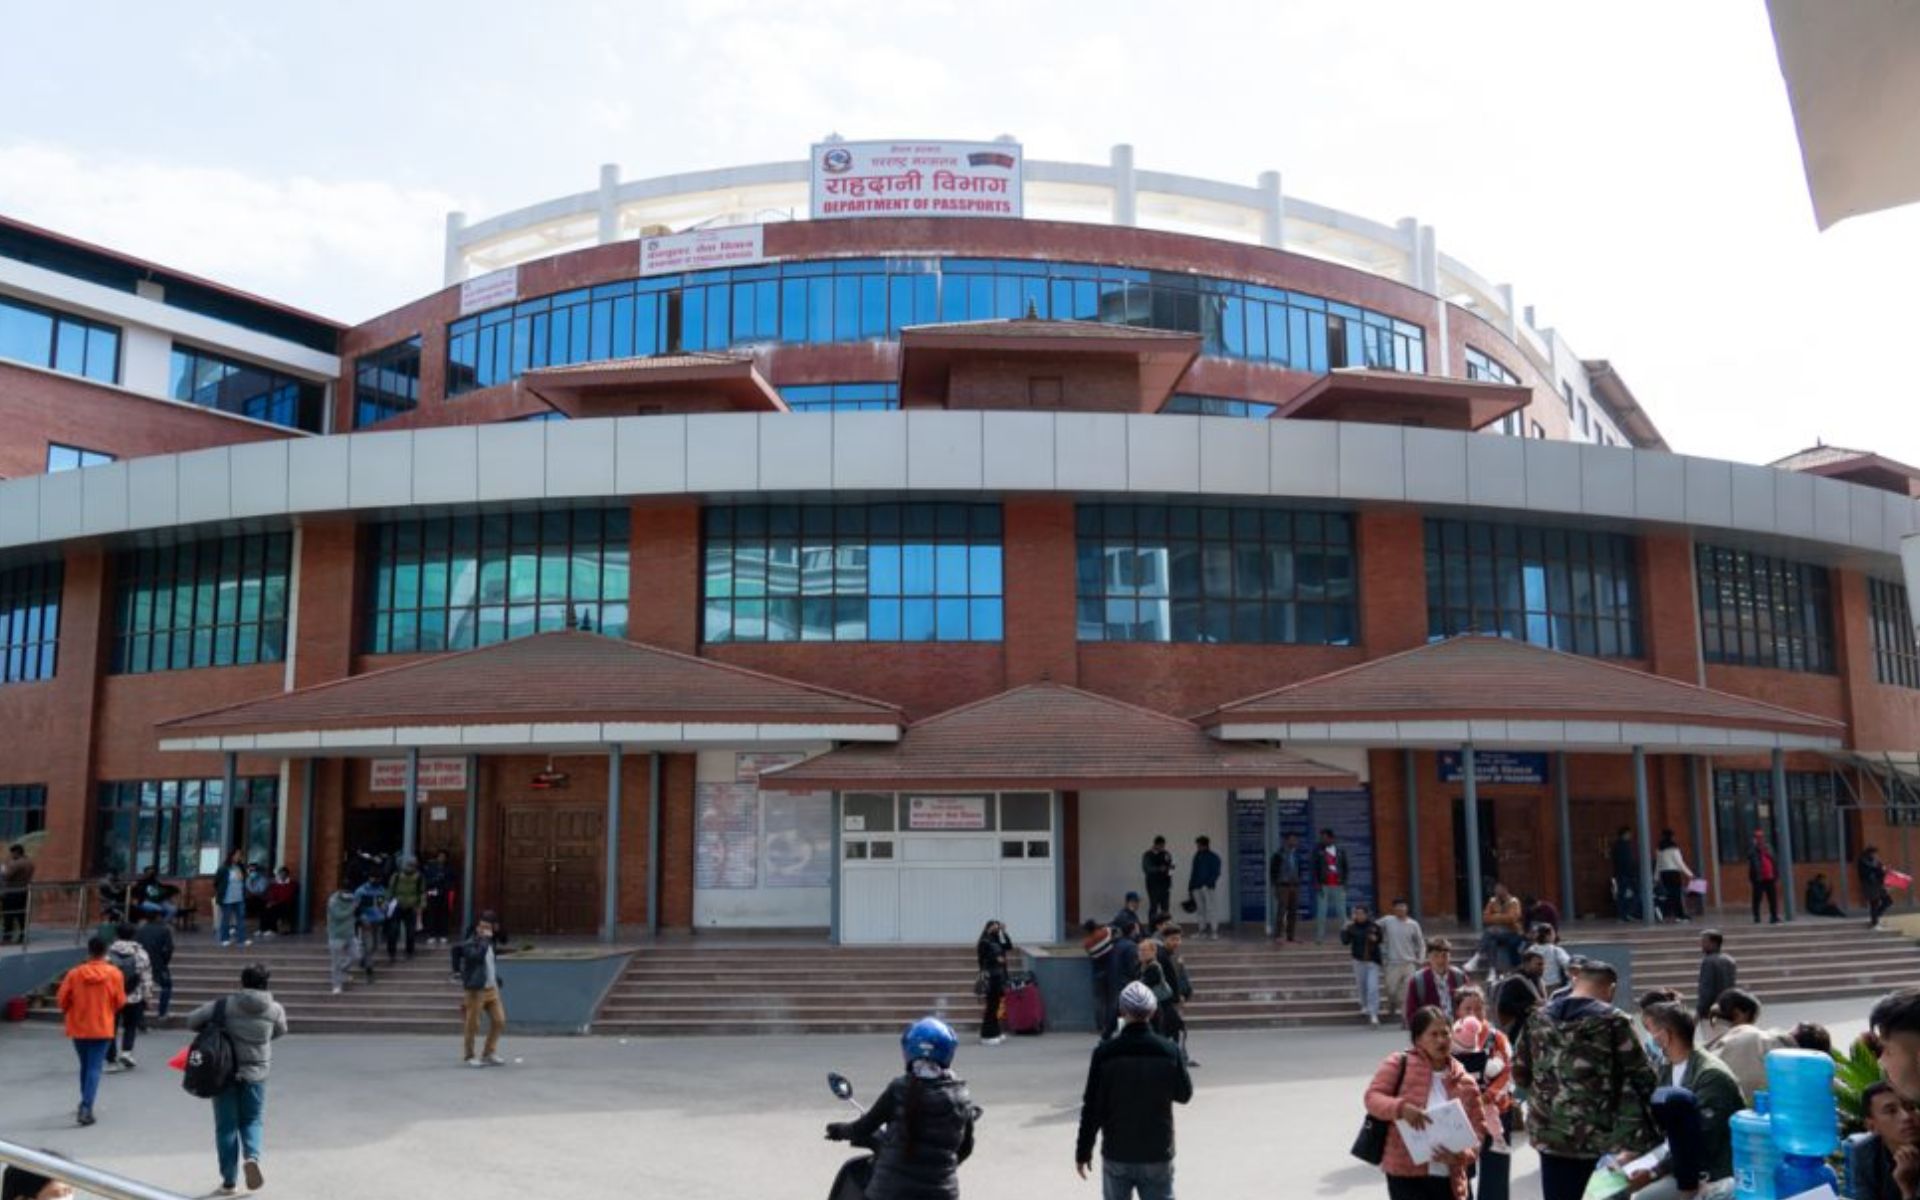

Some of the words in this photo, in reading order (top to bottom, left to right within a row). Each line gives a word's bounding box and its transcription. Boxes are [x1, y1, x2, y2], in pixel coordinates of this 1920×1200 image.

[825, 170, 924, 197] राहदानी
[933, 169, 1009, 193] विभाग
[824, 199, 909, 213] DEPARTMENT
[913, 199, 928, 210] OF
[933, 199, 1011, 213] PASSPORTS
